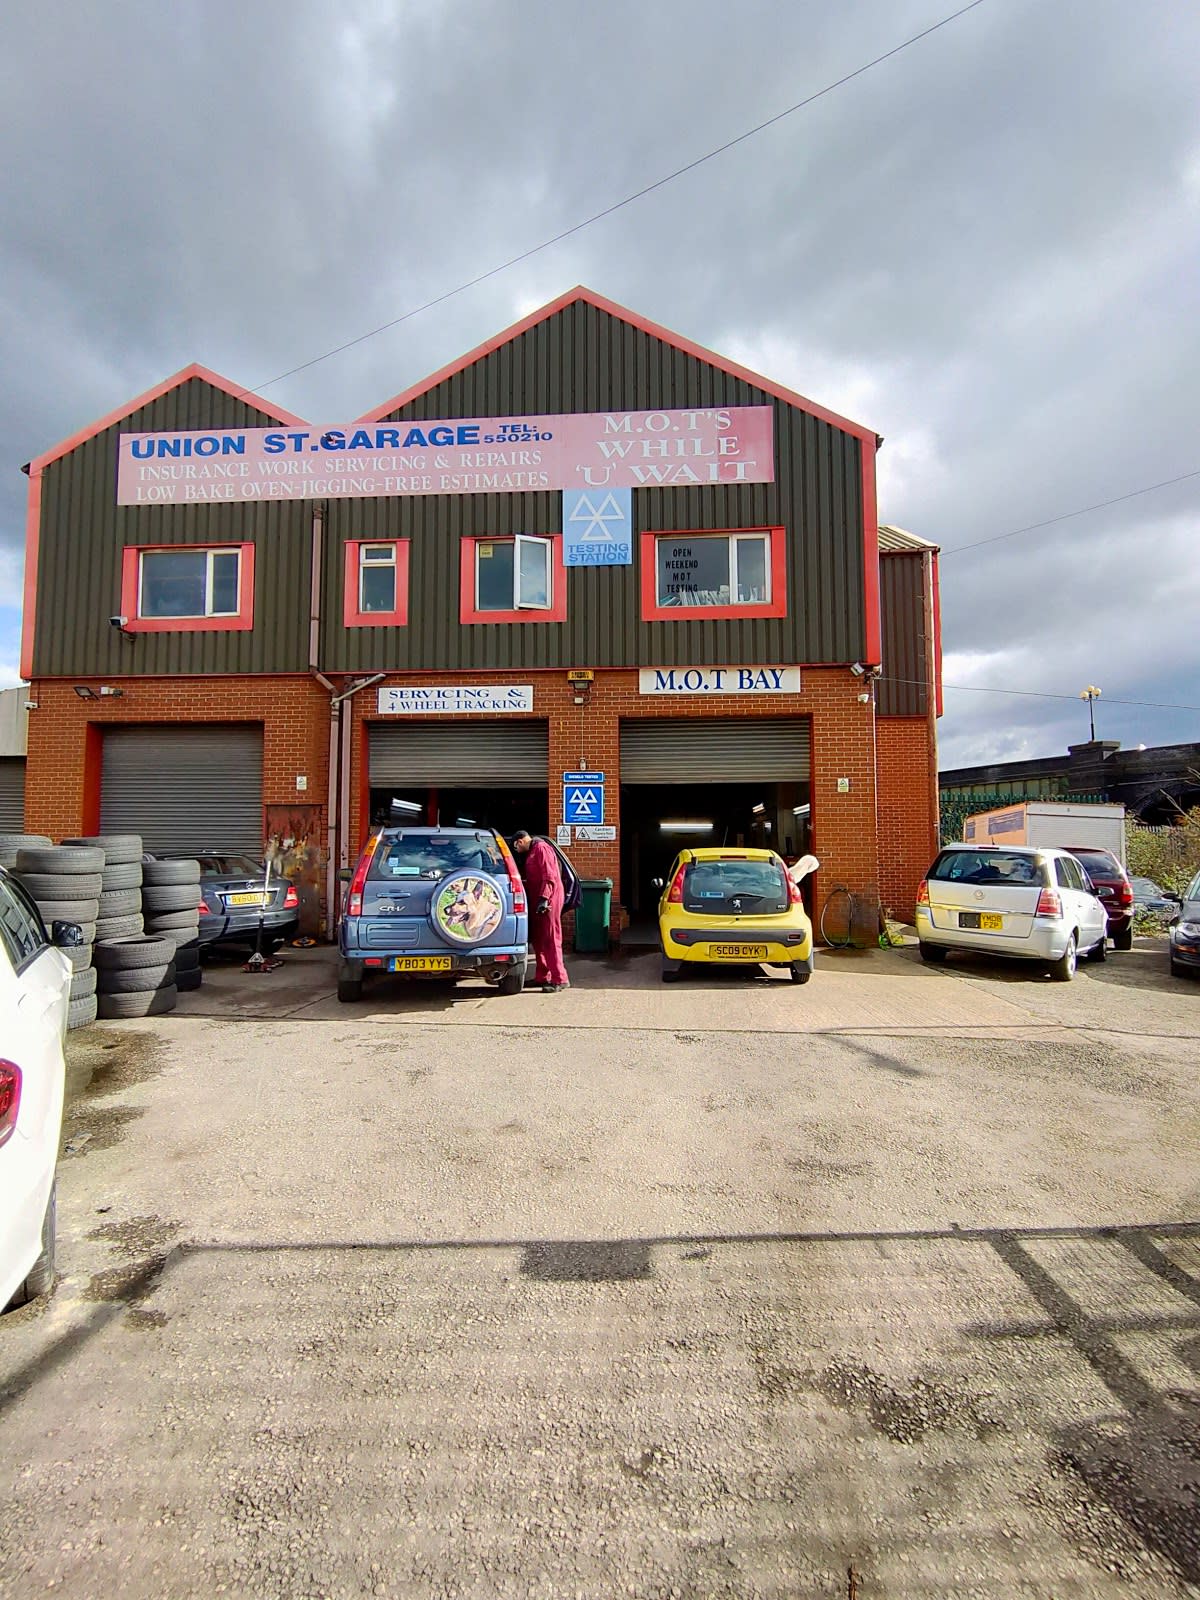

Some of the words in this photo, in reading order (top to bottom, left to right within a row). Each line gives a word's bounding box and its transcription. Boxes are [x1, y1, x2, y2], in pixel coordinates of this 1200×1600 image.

[603, 410, 732, 434] M.O.T'S
[499, 424, 538, 433] TEL:
[484, 432, 553, 444] 550210
[131, 435, 246, 459] UNION
[597, 436, 740, 459] WHILE
[139, 462, 249, 481] INSURANCE
[258, 459, 314, 476] WORK
[325, 455, 426, 473] SERVICING
[434, 454, 450, 469] &
[460, 450, 542, 468] REPAIRS
[628, 461, 757, 484] WAIT
[136, 485, 176, 501] LOW
[185, 483, 236, 500] BAKE
[440, 471, 549, 489] ESTIMATES
[568, 543, 629, 553] TESTING
[672, 548, 692, 557] OPEN
[568, 552, 628, 562] STATION
[665, 560, 698, 569] WEEKEND
[672, 572, 691, 581] MOT
[666, 584, 698, 593] TESTING
[653, 669, 728, 690] M.O.T
[736, 668, 787, 690] BAY
[389, 689, 489, 699] SERVICING
[507, 688, 525, 697] &
[388, 702, 396, 711] 4
[400, 701, 450, 710] WHEEL
[455, 700, 527, 709] TRACKING
[716, 946, 740, 955] SC09
[742, 945, 760, 955] CYK
[397, 958, 426, 969] YB03
[428, 958, 450, 969] YYS
